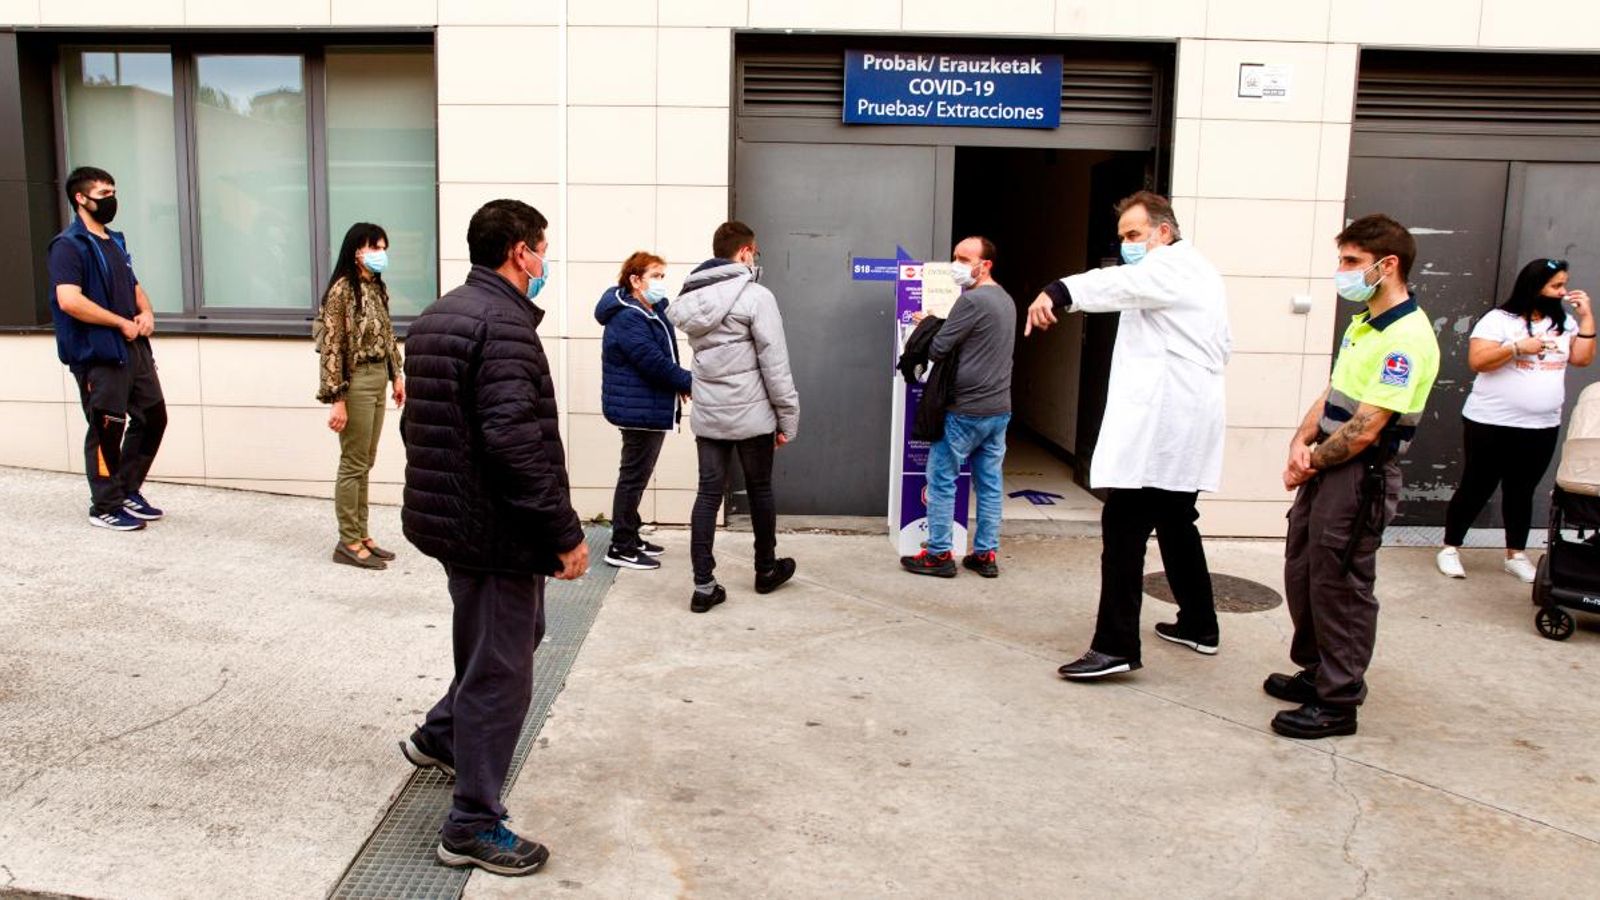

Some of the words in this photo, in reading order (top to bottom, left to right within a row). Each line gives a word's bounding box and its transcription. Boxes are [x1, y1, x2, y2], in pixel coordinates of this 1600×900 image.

[864, 54, 935, 72] Probak/
[940, 57, 1042, 74] Erauzketak
[908, 78, 995, 96] COVID-19
[858, 99, 933, 117] Pruebas/
[937, 101, 1044, 119] Extracciones
[854, 265, 870, 274] S18
